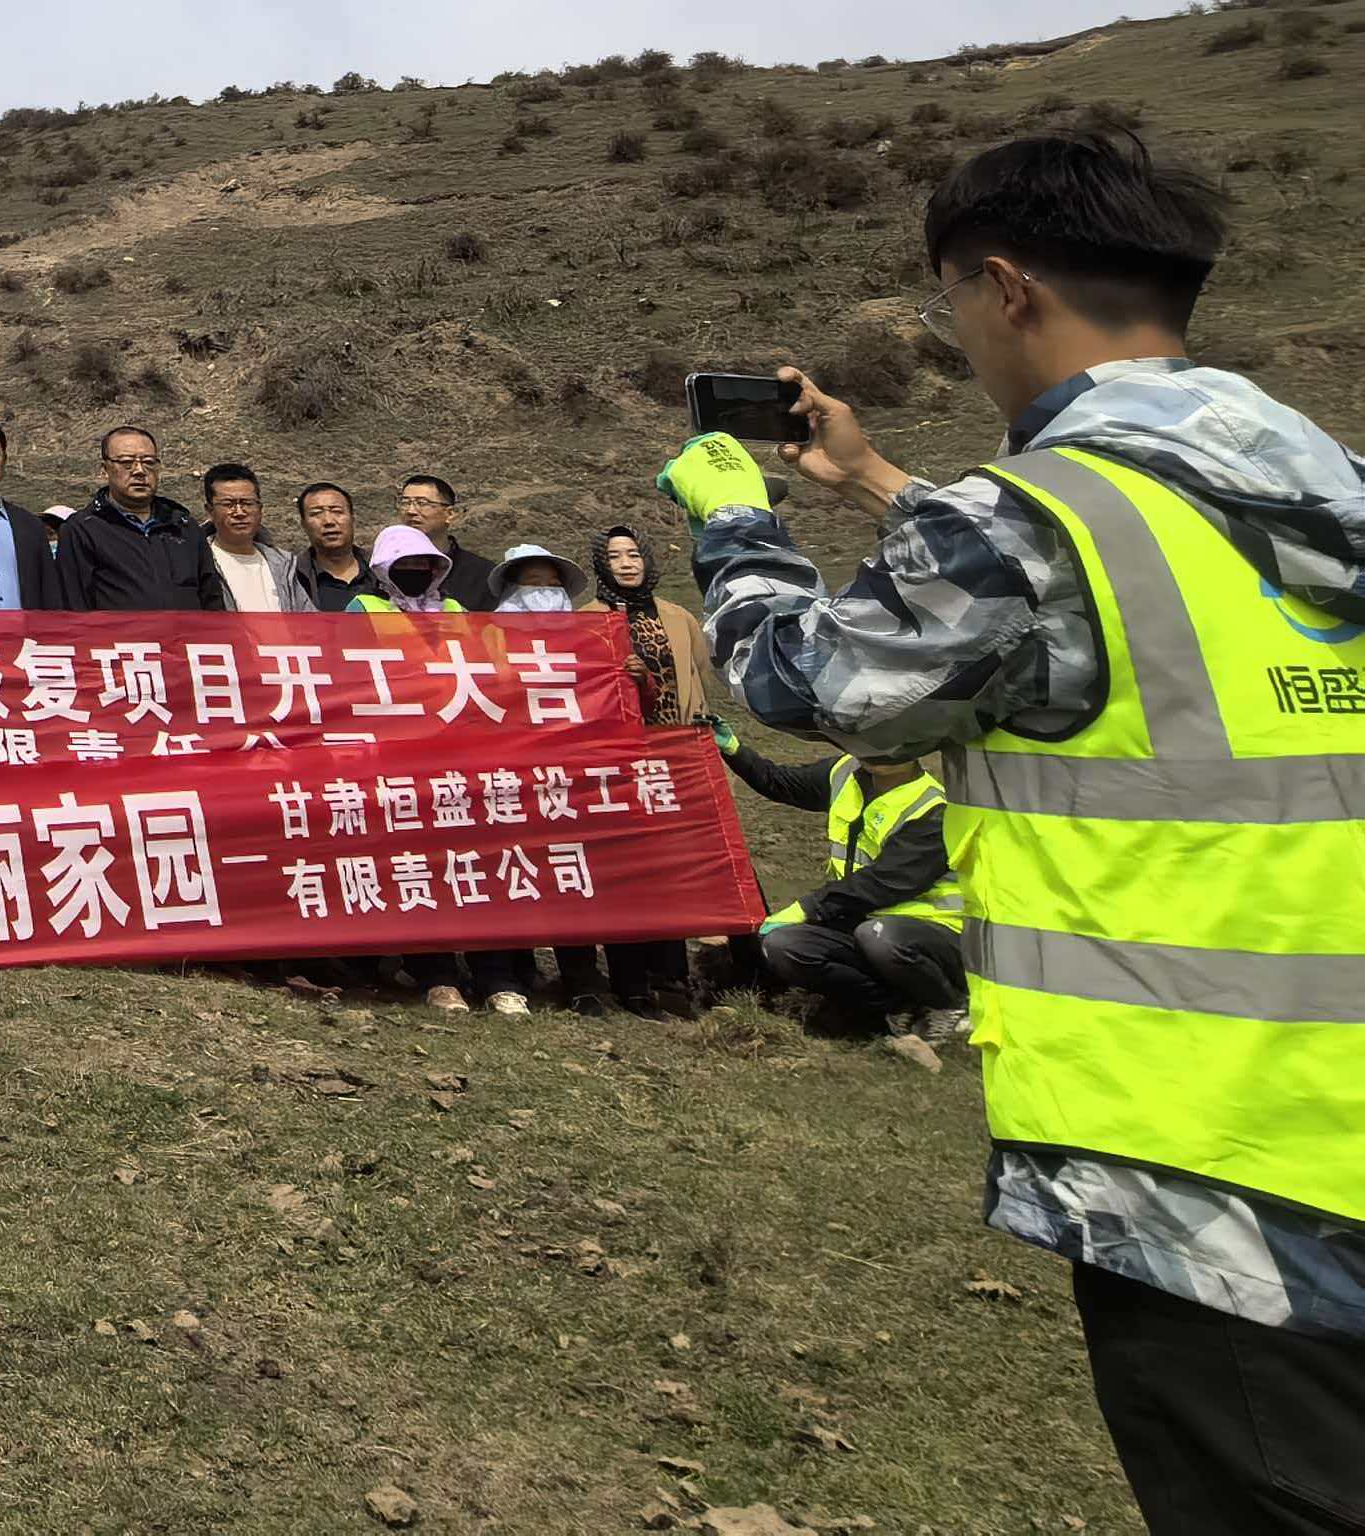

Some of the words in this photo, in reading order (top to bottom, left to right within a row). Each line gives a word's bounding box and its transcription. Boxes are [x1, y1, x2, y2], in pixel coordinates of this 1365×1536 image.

[269, 759, 681, 839] 甘肃恒盛建设工程
[282, 843, 595, 919] 有限责任公司
